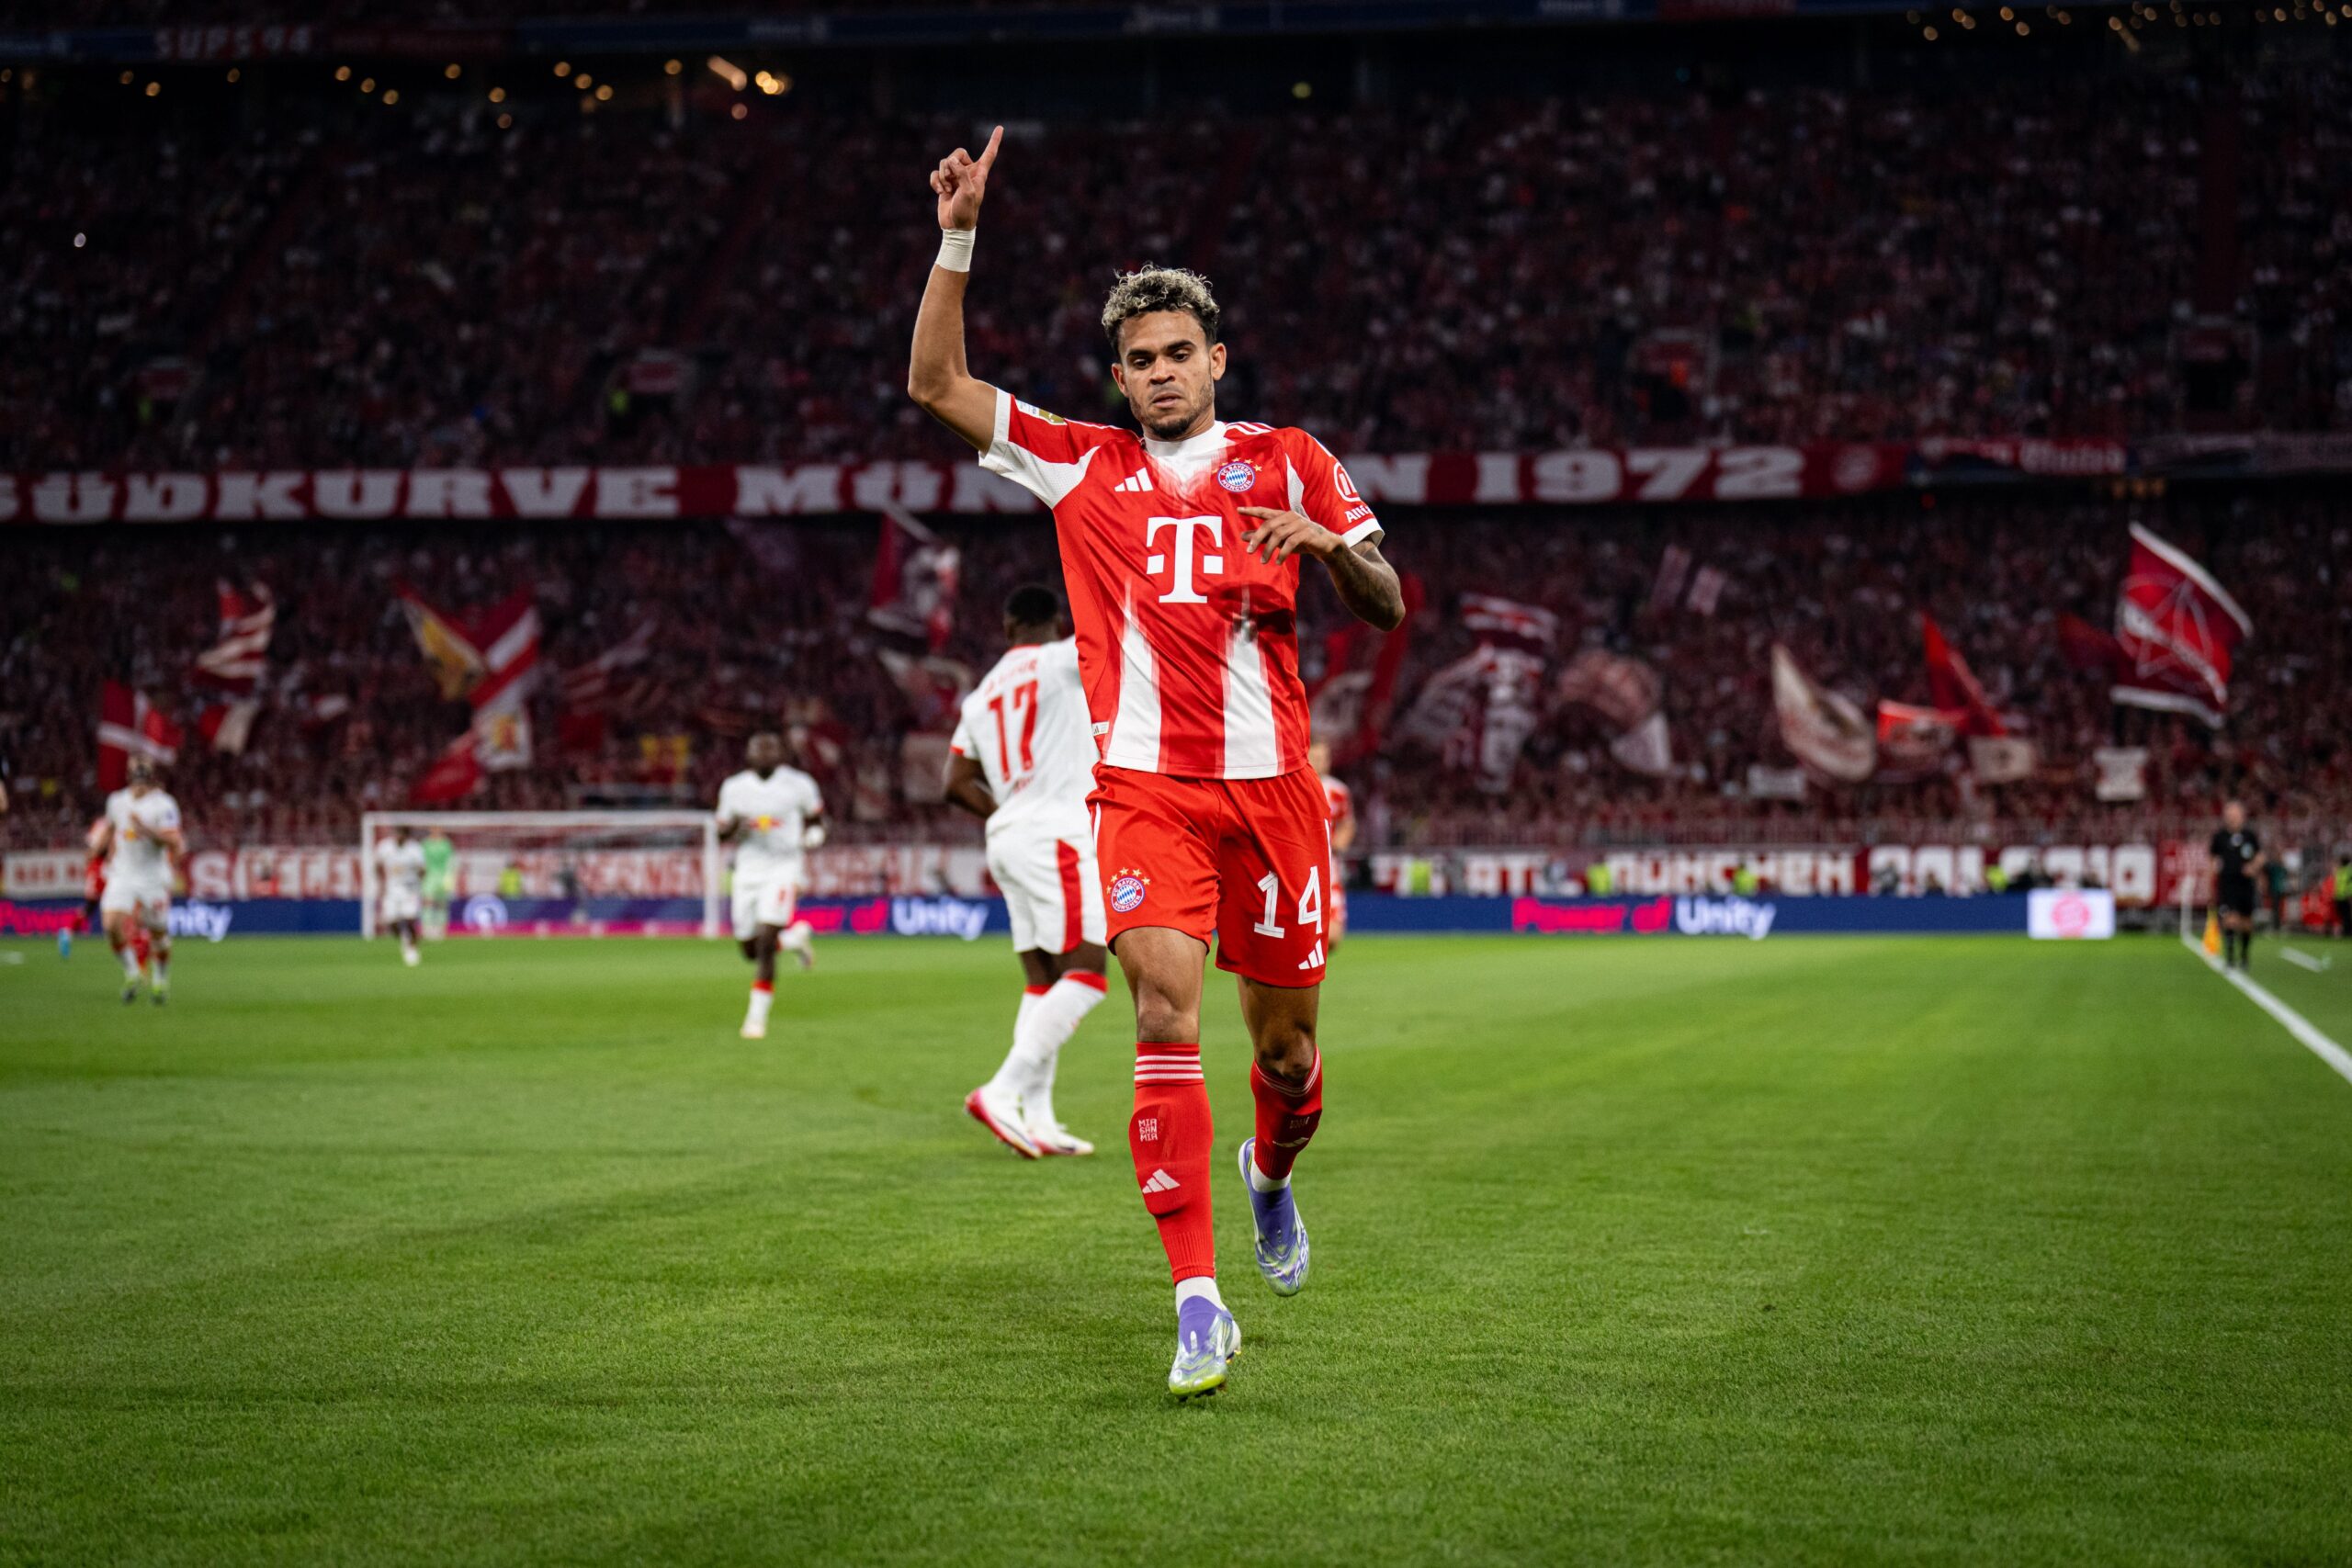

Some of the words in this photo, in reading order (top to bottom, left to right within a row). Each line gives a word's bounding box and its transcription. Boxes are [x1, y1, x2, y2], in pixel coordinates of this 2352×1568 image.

[1474, 446, 1806, 504] 1972
[1147, 516, 1223, 604] T
[988, 678, 1038, 784] 17
[892, 895, 989, 941] Unity
[1253, 865, 1323, 939] 14
[1676, 896, 1776, 941] Unity
[1138, 1118, 1157, 1127] MIA
[1140, 1133, 1158, 1142] MIA
